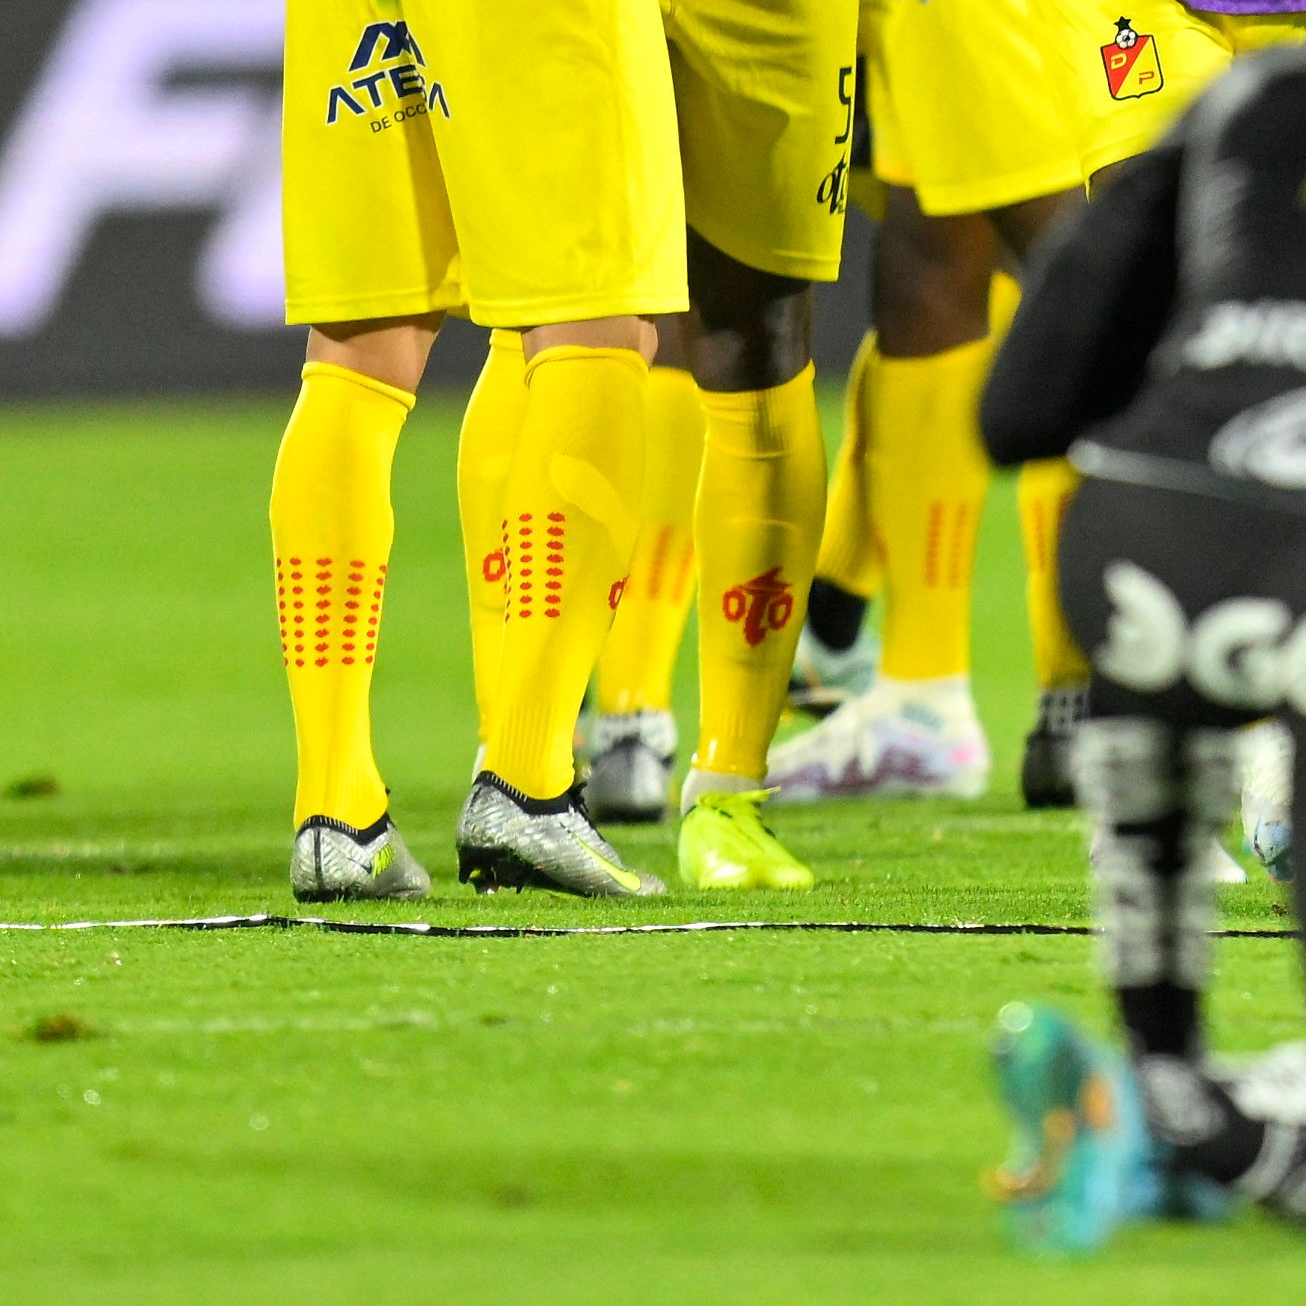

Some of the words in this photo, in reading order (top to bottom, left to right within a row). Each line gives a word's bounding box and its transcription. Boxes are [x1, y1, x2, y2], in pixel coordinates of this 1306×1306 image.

[1110, 52, 1128, 70] D
[1138, 70, 1155, 85] P
[327, 64, 451, 124] ATEA
[369, 116, 392, 133] DE
